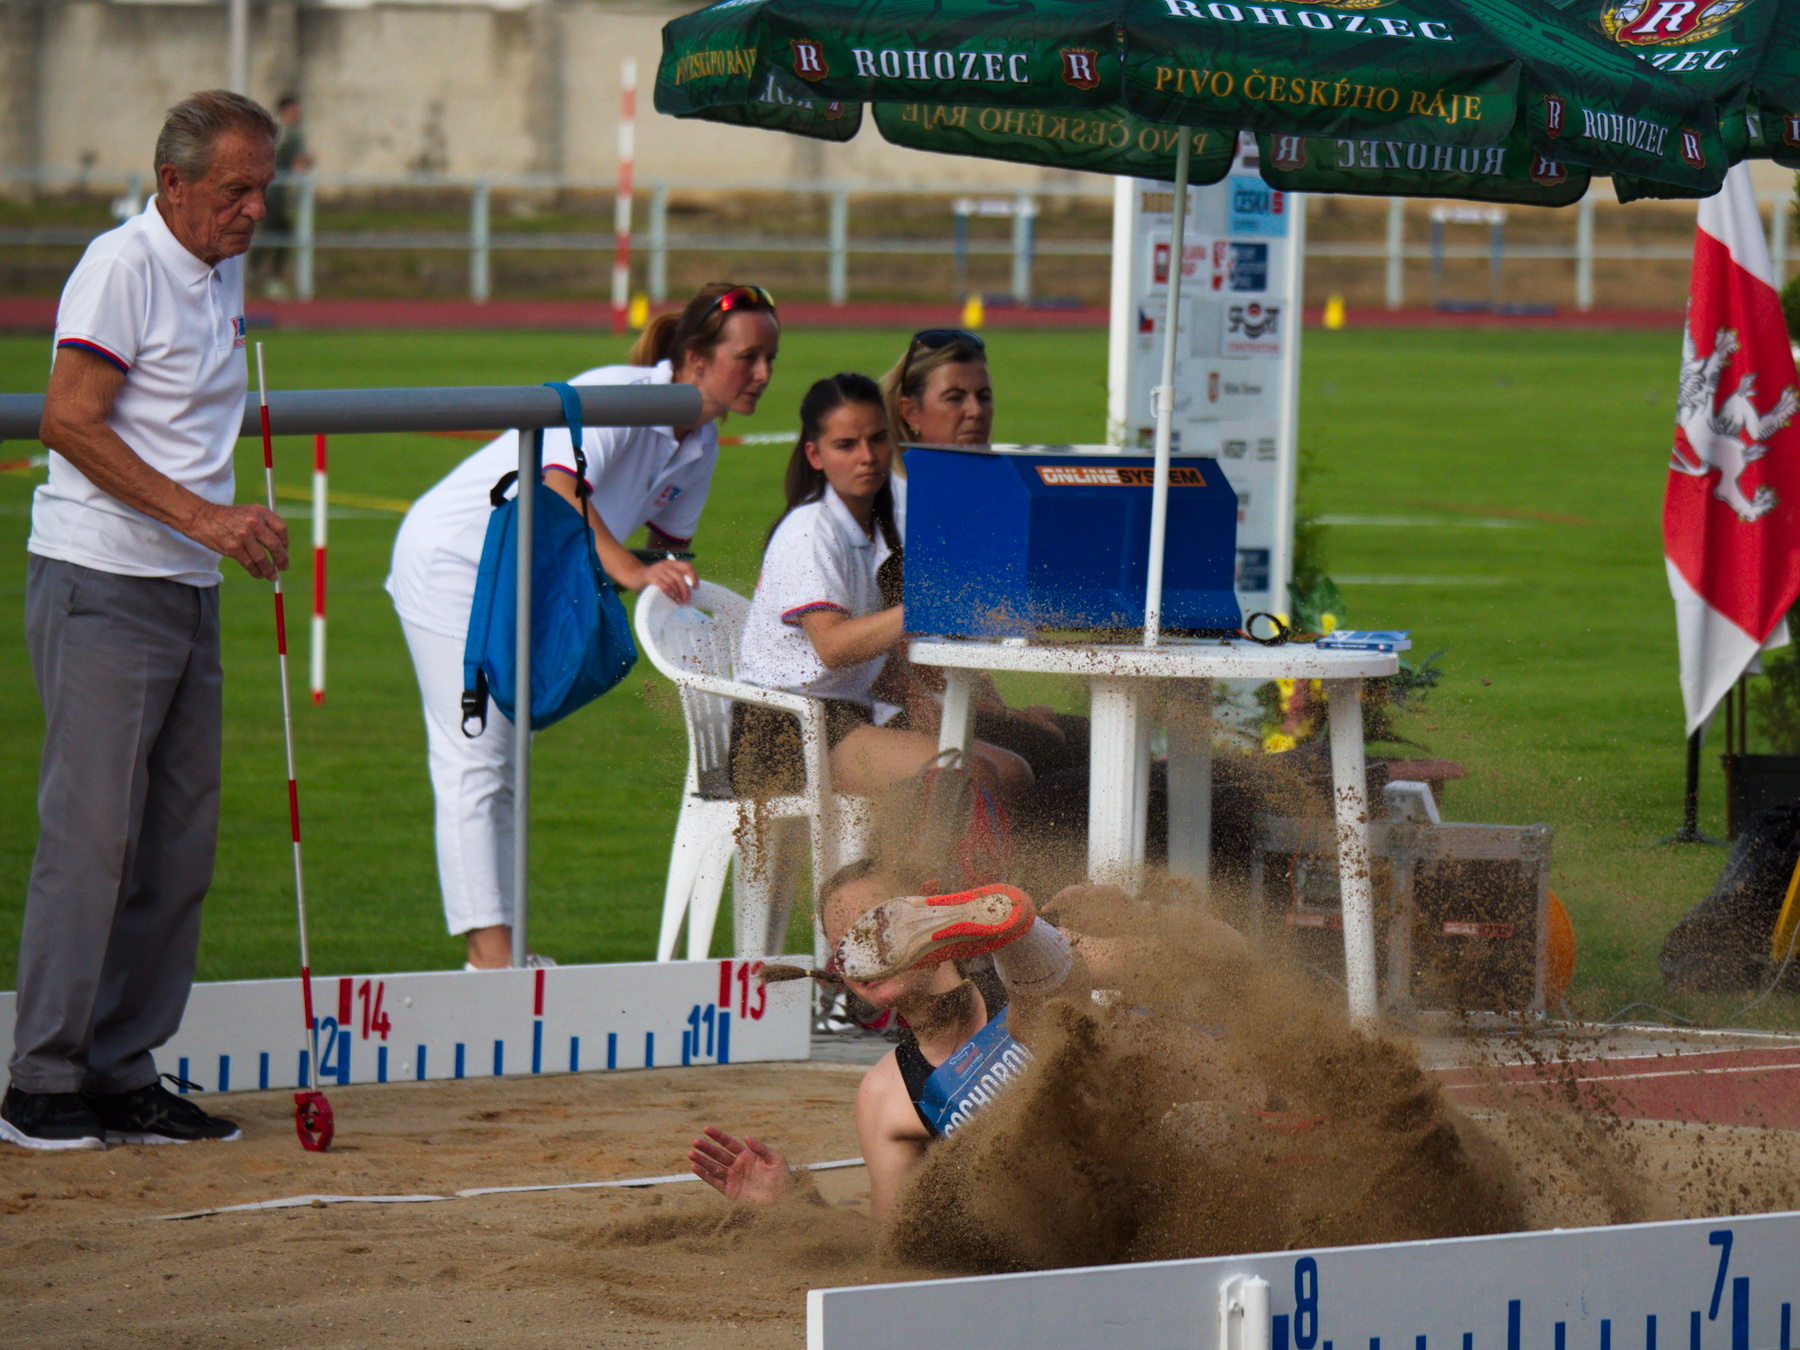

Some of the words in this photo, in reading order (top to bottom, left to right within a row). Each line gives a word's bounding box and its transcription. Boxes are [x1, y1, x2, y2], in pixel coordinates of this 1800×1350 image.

[1164, 0, 1454, 42] ROHOZEC
[1632, 1, 1698, 34] R
[797, 44, 822, 72] R
[852, 49, 1030, 84] ROHOZEC
[1067, 53, 1093, 82] R
[1154, 66, 1235, 98] PIVO
[1243, 69, 1399, 113] ČESKÉHO
[1407, 88, 1482, 124] RÁJE
[1549, 100, 1561, 129] R
[1582, 108, 1669, 157] ROHOZEC
[1683, 133, 1701, 161] R
[358, 979, 392, 1041] 14
[737, 961, 767, 1021] 13
[687, 1004, 716, 1058] 11
[1294, 1256, 1319, 1350] 8
[1709, 1230, 1734, 1321] 7
